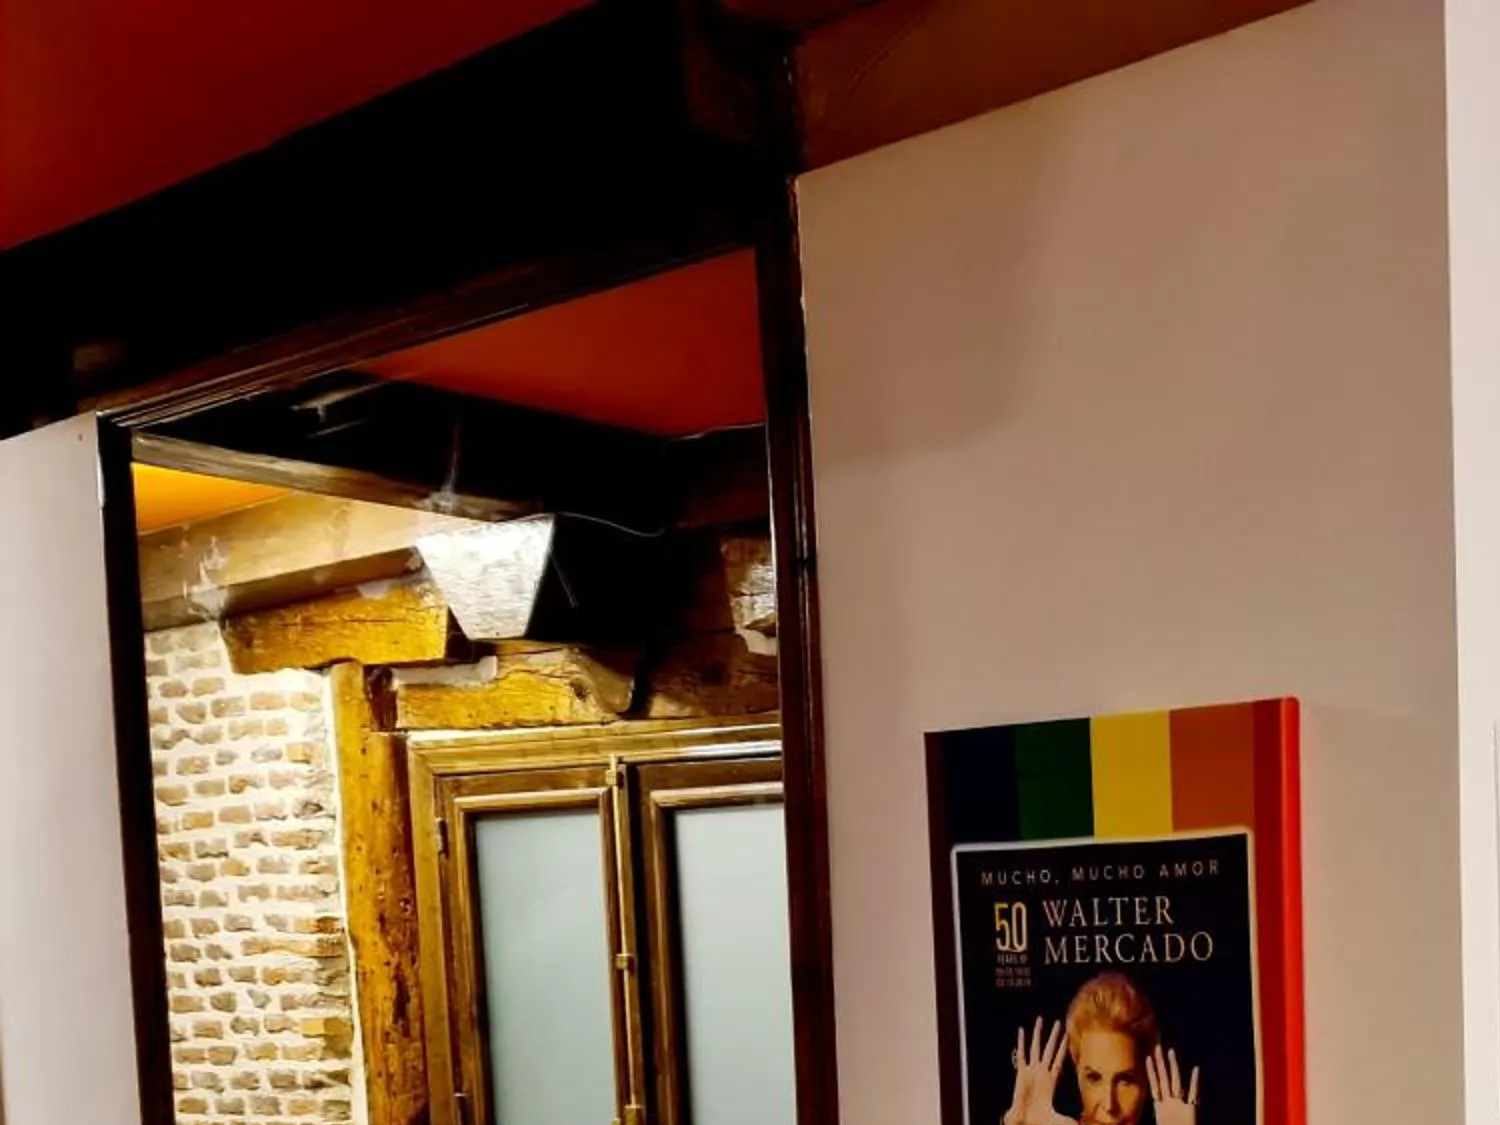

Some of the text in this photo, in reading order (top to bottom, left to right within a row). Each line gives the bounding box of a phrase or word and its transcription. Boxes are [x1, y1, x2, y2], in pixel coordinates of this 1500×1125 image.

[980, 858, 1220, 886] MUCHO, MUCHO AMOR
[994, 901, 1028, 953] 50
[1042, 895, 1175, 928] WALTER
[1044, 931, 1214, 965] MERCADO
